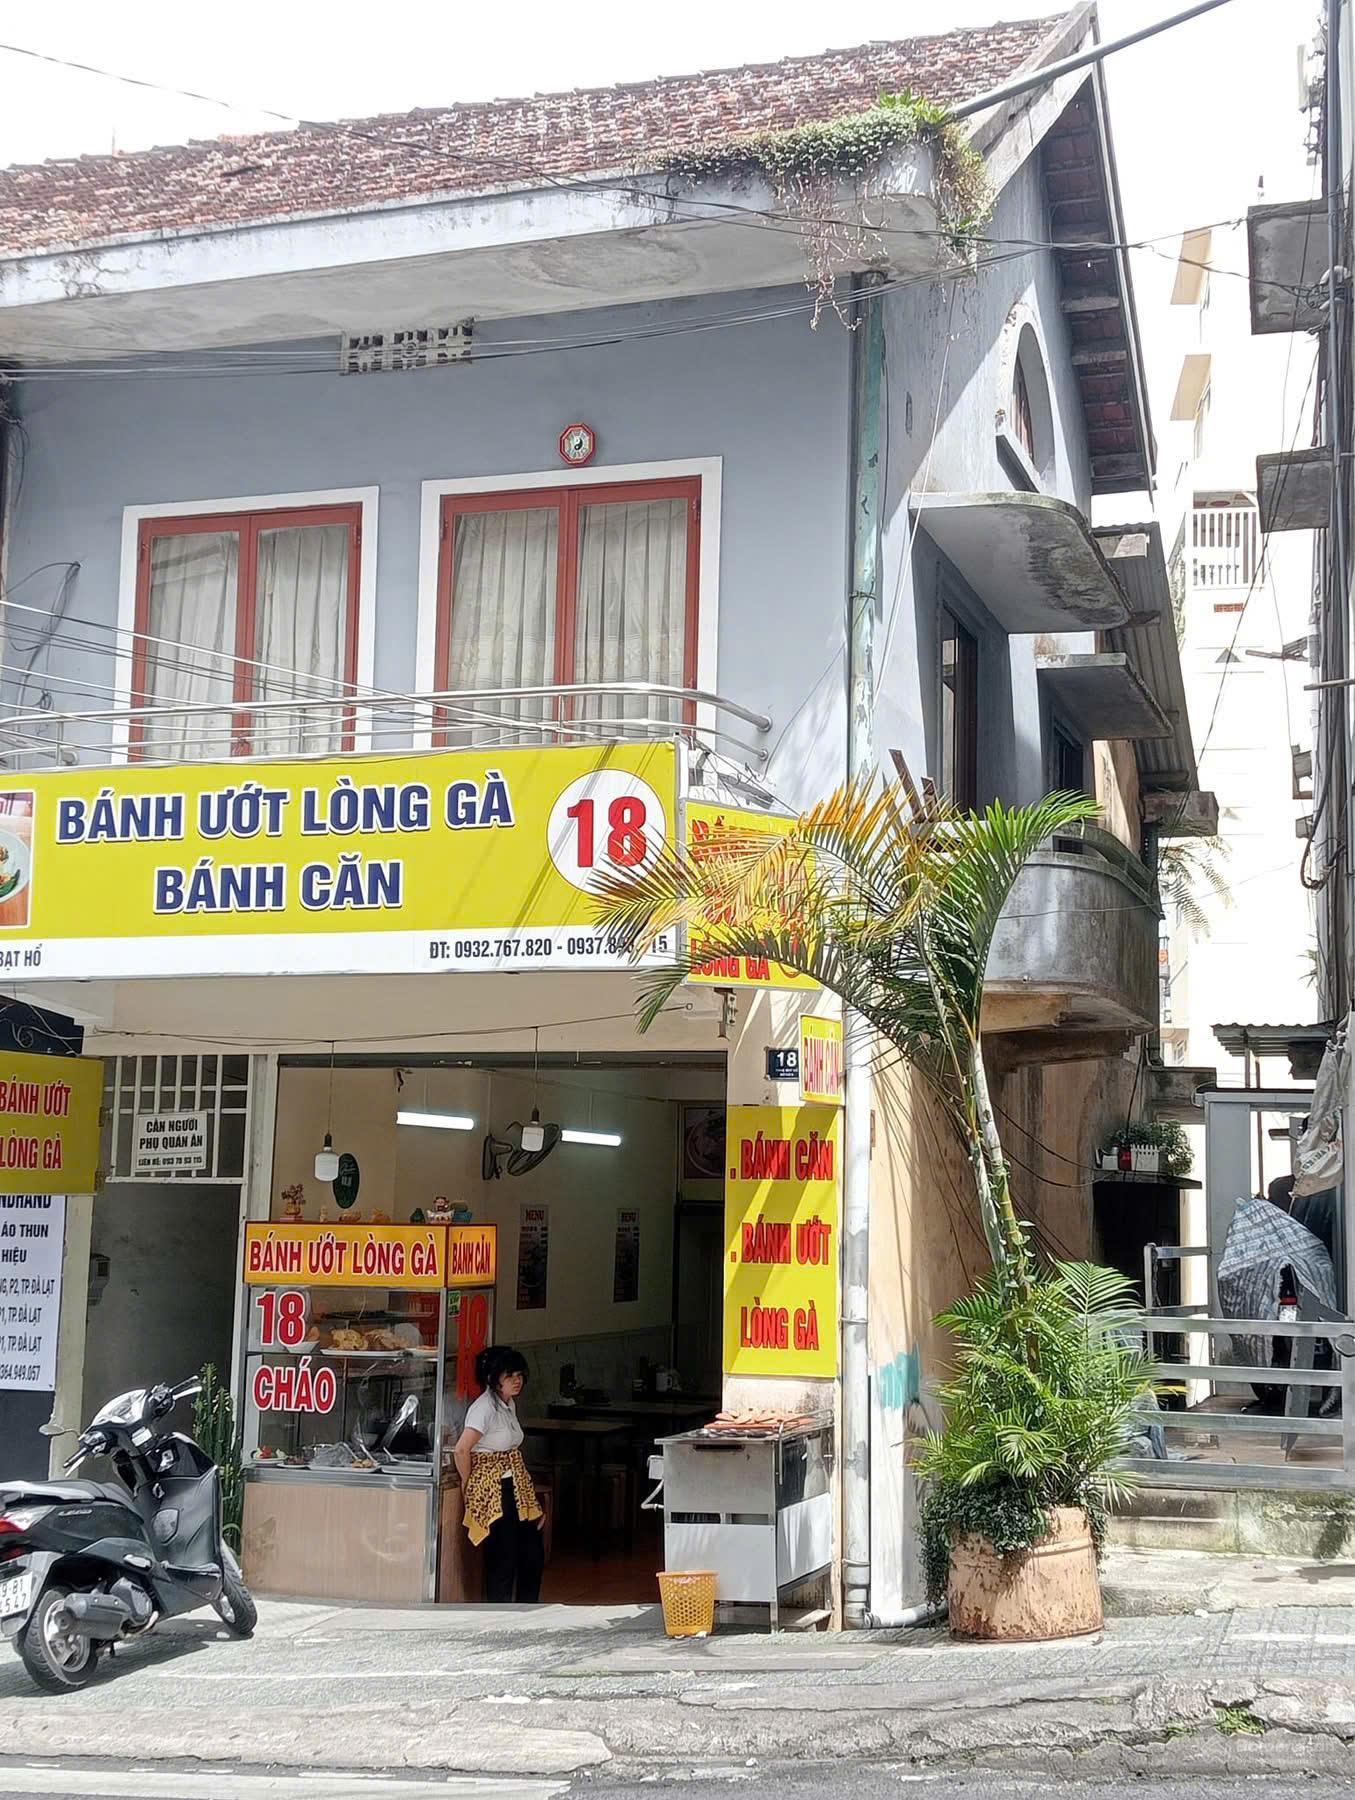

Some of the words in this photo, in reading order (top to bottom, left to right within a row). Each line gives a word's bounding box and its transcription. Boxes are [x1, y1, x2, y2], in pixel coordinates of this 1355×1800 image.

[59, 789, 182, 840] BÁNH
[200, 783, 288, 835] ƯỚT
[304, 778, 428, 831] LÒNG
[448, 771, 512, 826] GÀ
[567, 796, 647, 868] 18
[157, 857, 284, 910] BÁNH
[302, 855, 400, 907] CĂN
[454, 938, 552, 959] 0932.767.820
[777, 1051, 797, 1067] 18
[0, 1075, 40, 1115] BÁNH
[43, 1080, 71, 1116] ƯỚT
[43, 1132, 62, 1169] GÀ
[741, 1131, 791, 1181] BÁNH
[795, 1131, 833, 1181] CĂN
[1, 1221, 16, 1237] ÁO
[19, 1224, 49, 1238] THUN
[741, 1214, 792, 1264] BÁNH
[795, 1214, 832, 1265] ƯỚT
[1, 1246, 27, 1266] HIỆU
[249, 1232, 302, 1272] BÁNH
[308, 1233, 347, 1273] ƯỚT
[352, 1233, 405, 1275] LÒNG
[411, 1233, 438, 1275] GÀ
[452, 1234, 474, 1274] BÁNH
[258, 1292, 304, 1345] 18
[740, 1297, 790, 1350] LÒNG
[793, 1301, 819, 1350] GÀ
[254, 1357, 334, 1412] CHÁO
